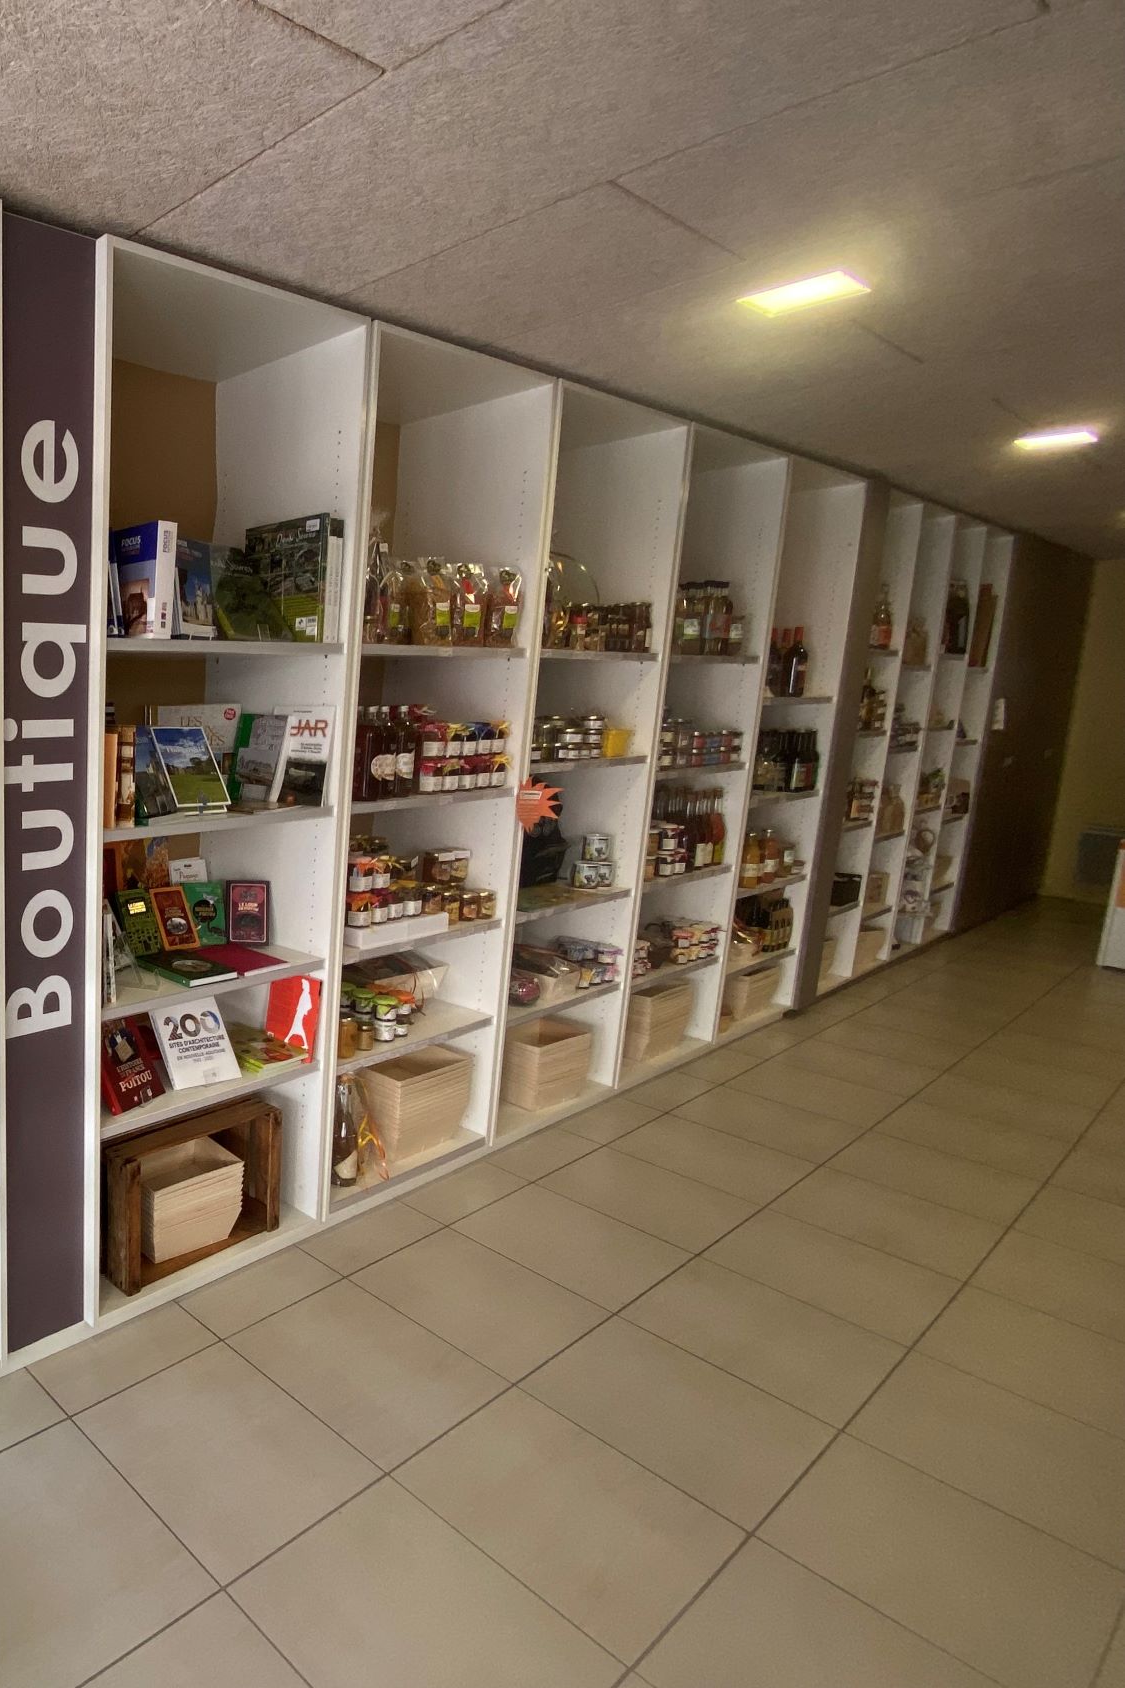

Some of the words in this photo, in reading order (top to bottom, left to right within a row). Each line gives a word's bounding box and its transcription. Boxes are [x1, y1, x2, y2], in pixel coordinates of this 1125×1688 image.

[4, 420, 86, 1039] Boutique
[164, 1011, 220, 1041] 200
[169, 1040, 184, 1049] SITES
[119, 1070, 153, 1092] POITOU
